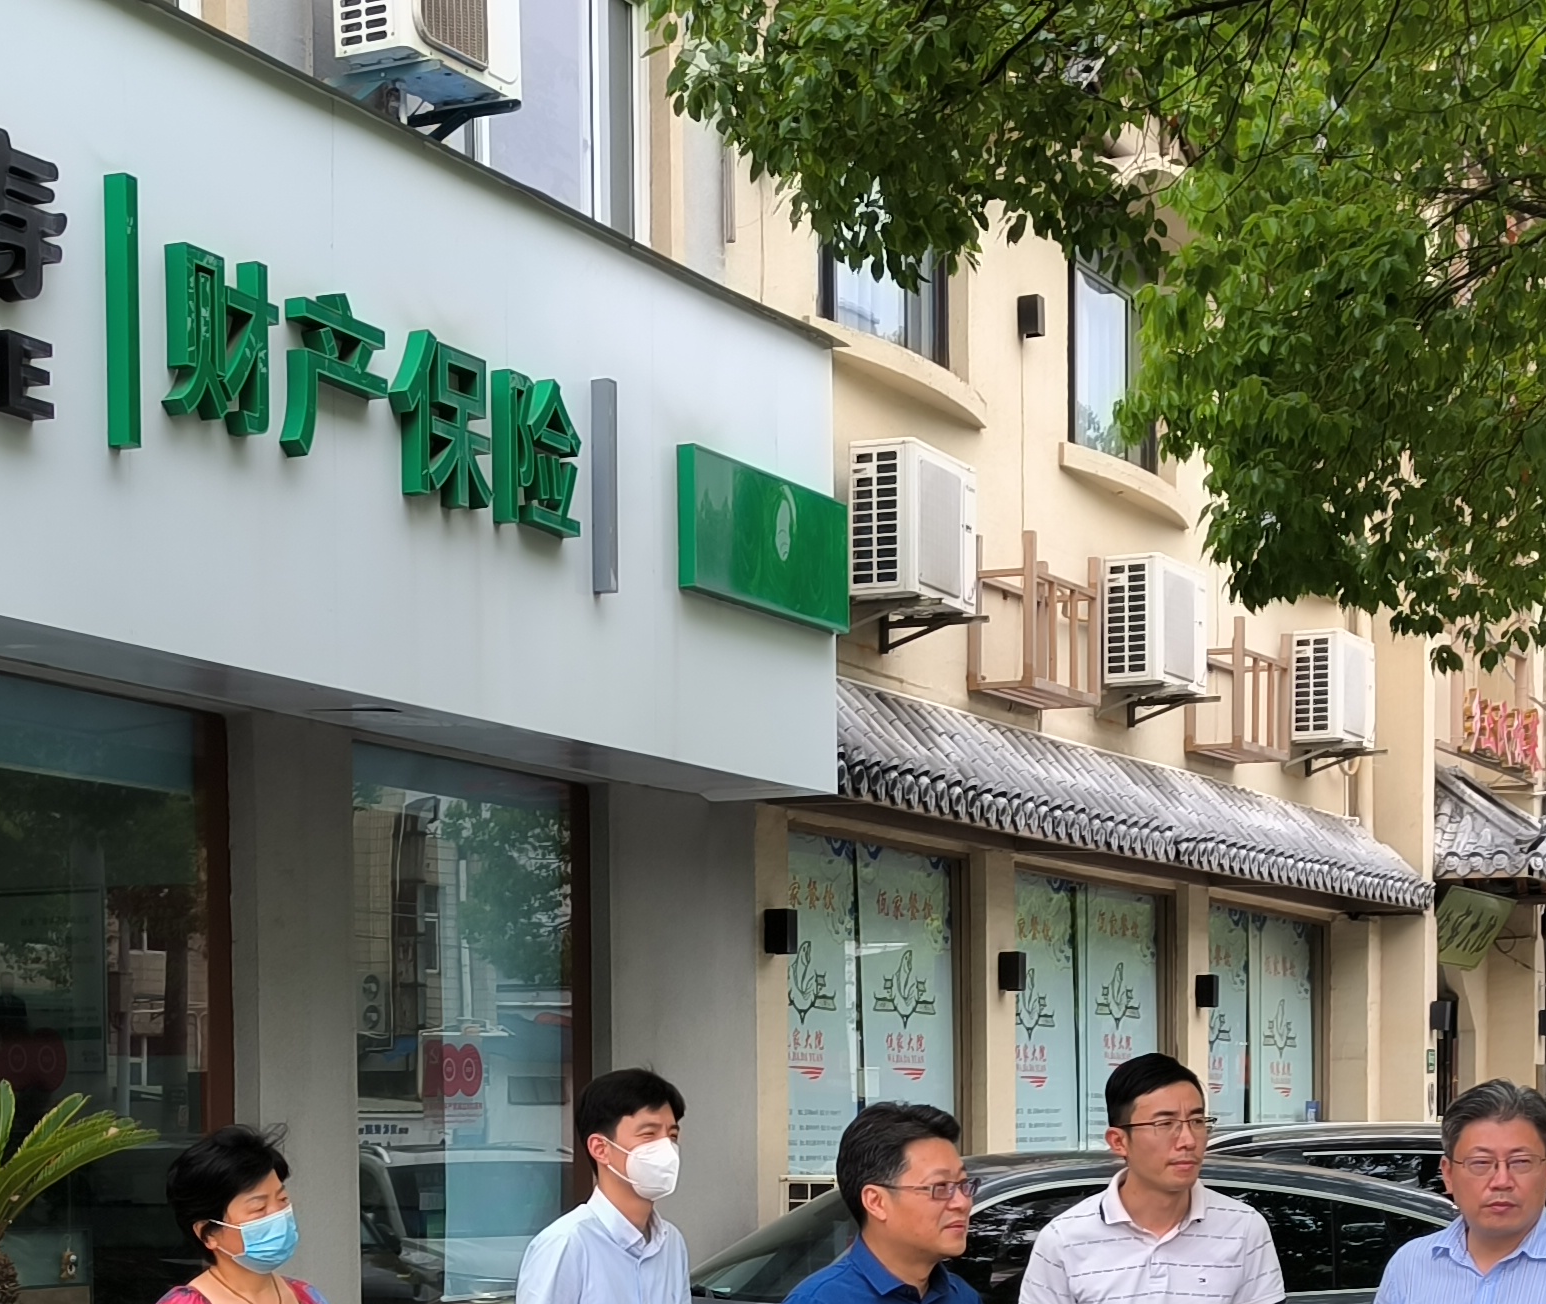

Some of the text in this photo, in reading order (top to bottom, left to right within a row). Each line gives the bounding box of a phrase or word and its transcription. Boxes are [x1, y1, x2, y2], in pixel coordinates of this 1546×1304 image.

[162, 242, 582, 538] 财产保险
[788, 1028, 824, 1051] 家大院
